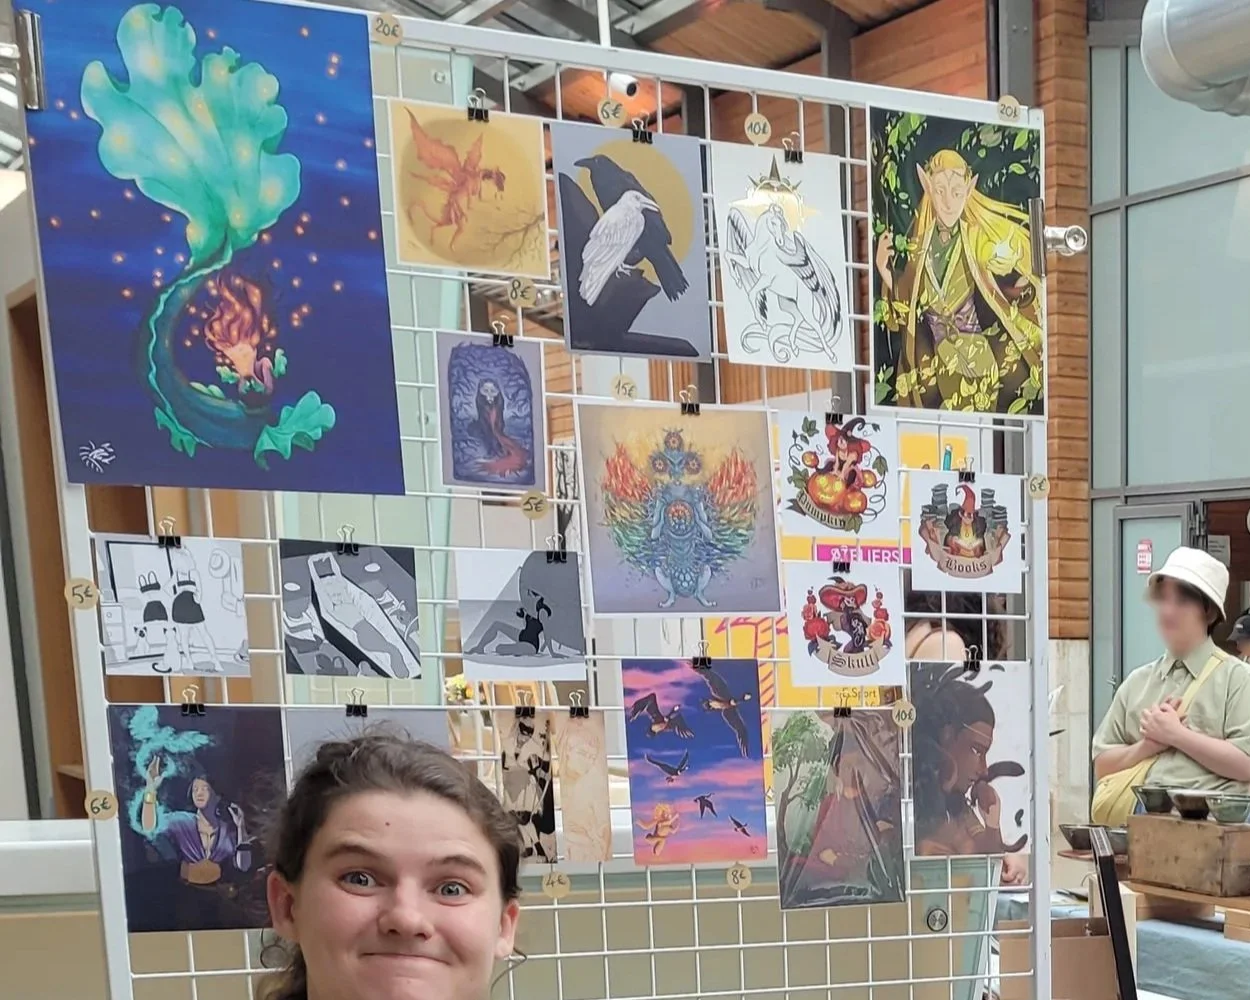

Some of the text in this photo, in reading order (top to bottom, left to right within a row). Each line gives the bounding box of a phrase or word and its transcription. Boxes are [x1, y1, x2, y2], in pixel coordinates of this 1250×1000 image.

[375, 17, 400, 38] 20€
[600, 103, 623, 119] 6€
[747, 121, 768, 135] 10€
[510, 279, 531, 300] 8€
[615, 381, 635, 397] 15€
[1030, 478, 1045, 492] 6€
[523, 496, 544, 514] 5€
[945, 558, 987, 573] Books
[72, 584, 94, 604] 5€
[831, 653, 876, 668] Skull
[895, 709, 913, 721] 10€
[89, 798, 112, 816] 6€
[545, 874, 567, 888] 4€
[731, 871, 747, 885] 8€
